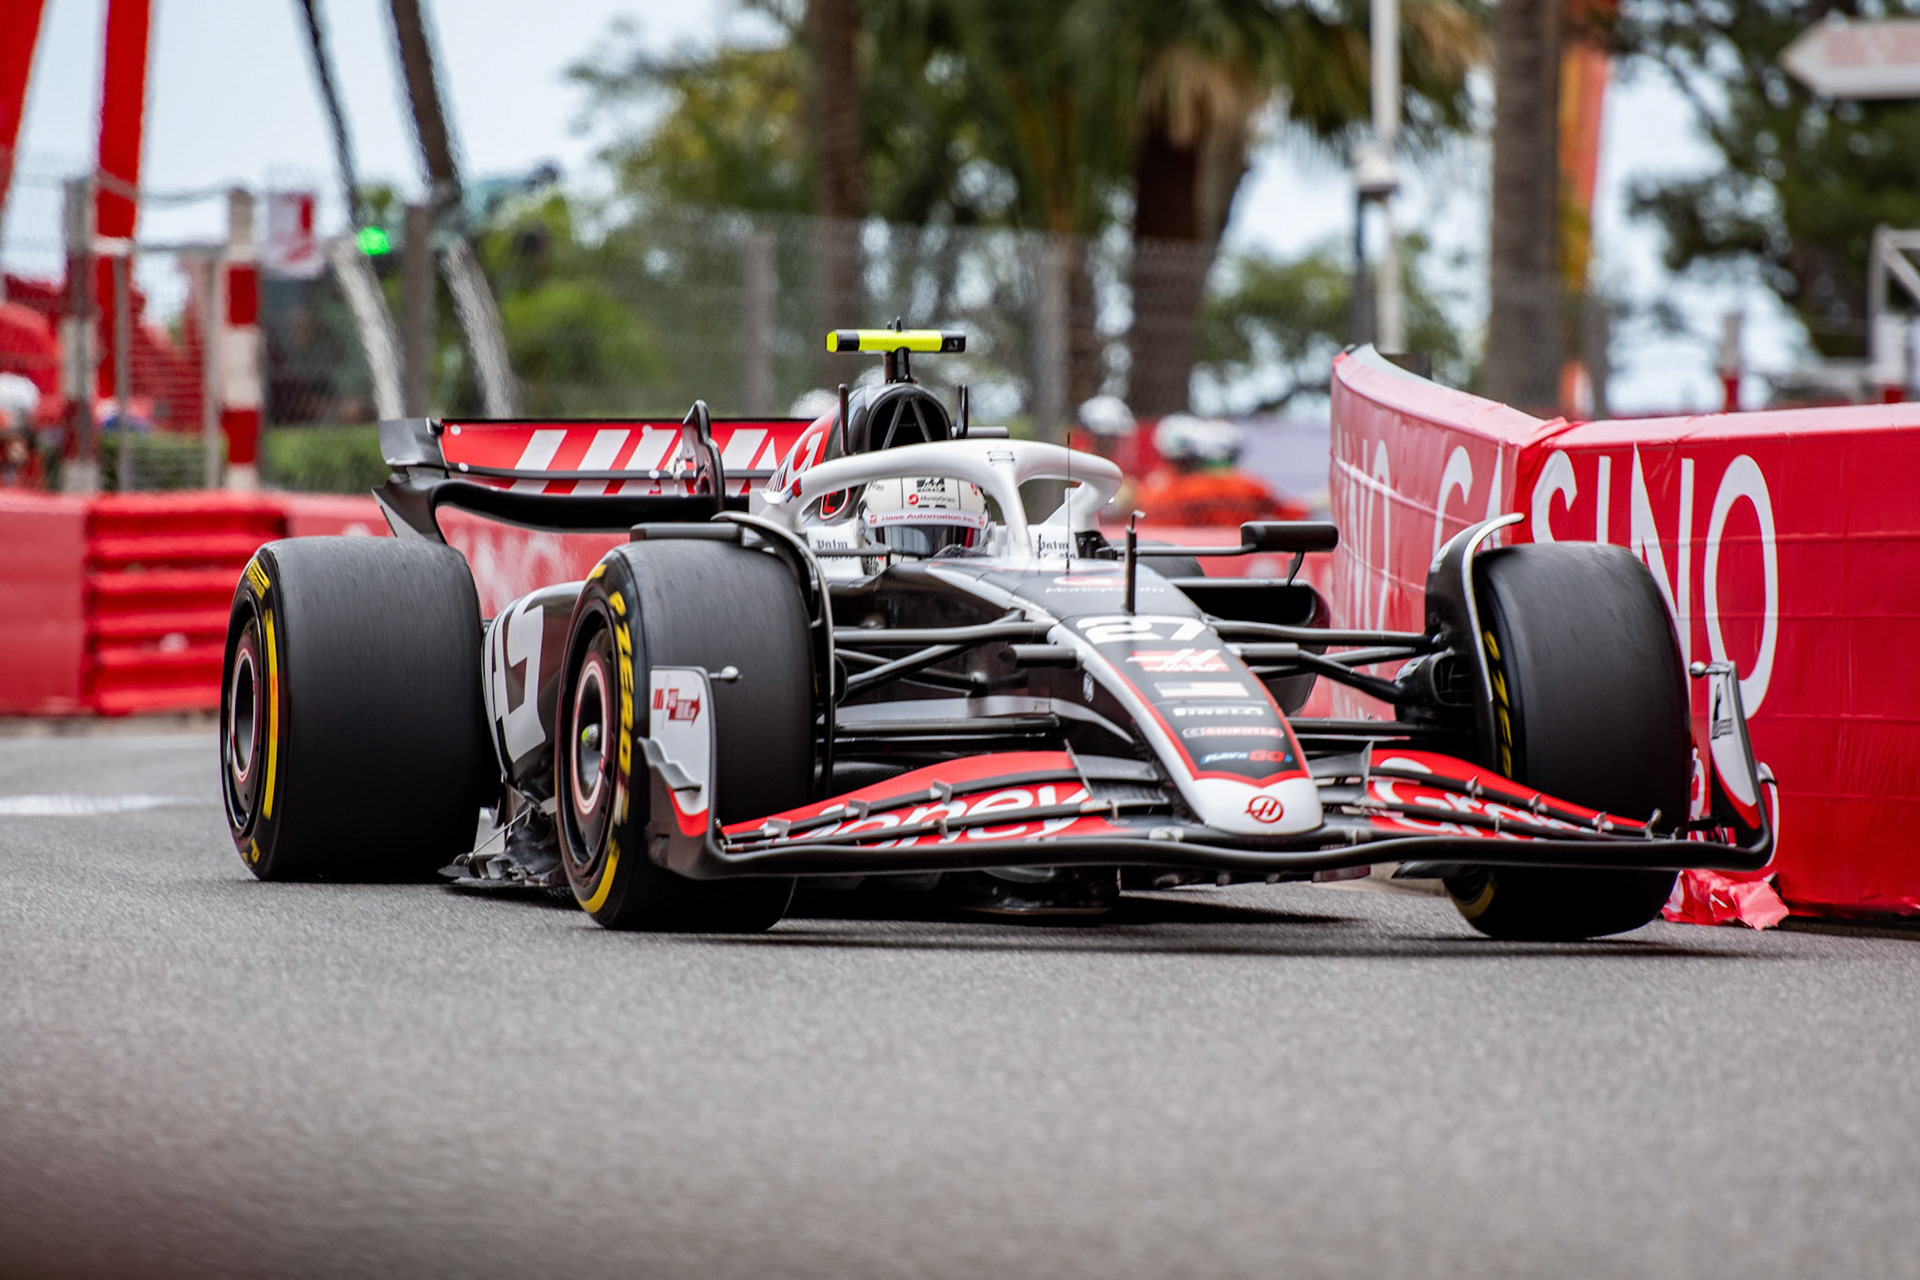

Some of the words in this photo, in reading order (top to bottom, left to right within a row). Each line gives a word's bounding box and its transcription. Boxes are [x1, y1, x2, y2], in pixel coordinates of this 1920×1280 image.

[608, 590, 626, 616] P
[1076, 614, 1207, 645] 27
[616, 621, 635, 778] ZERO
